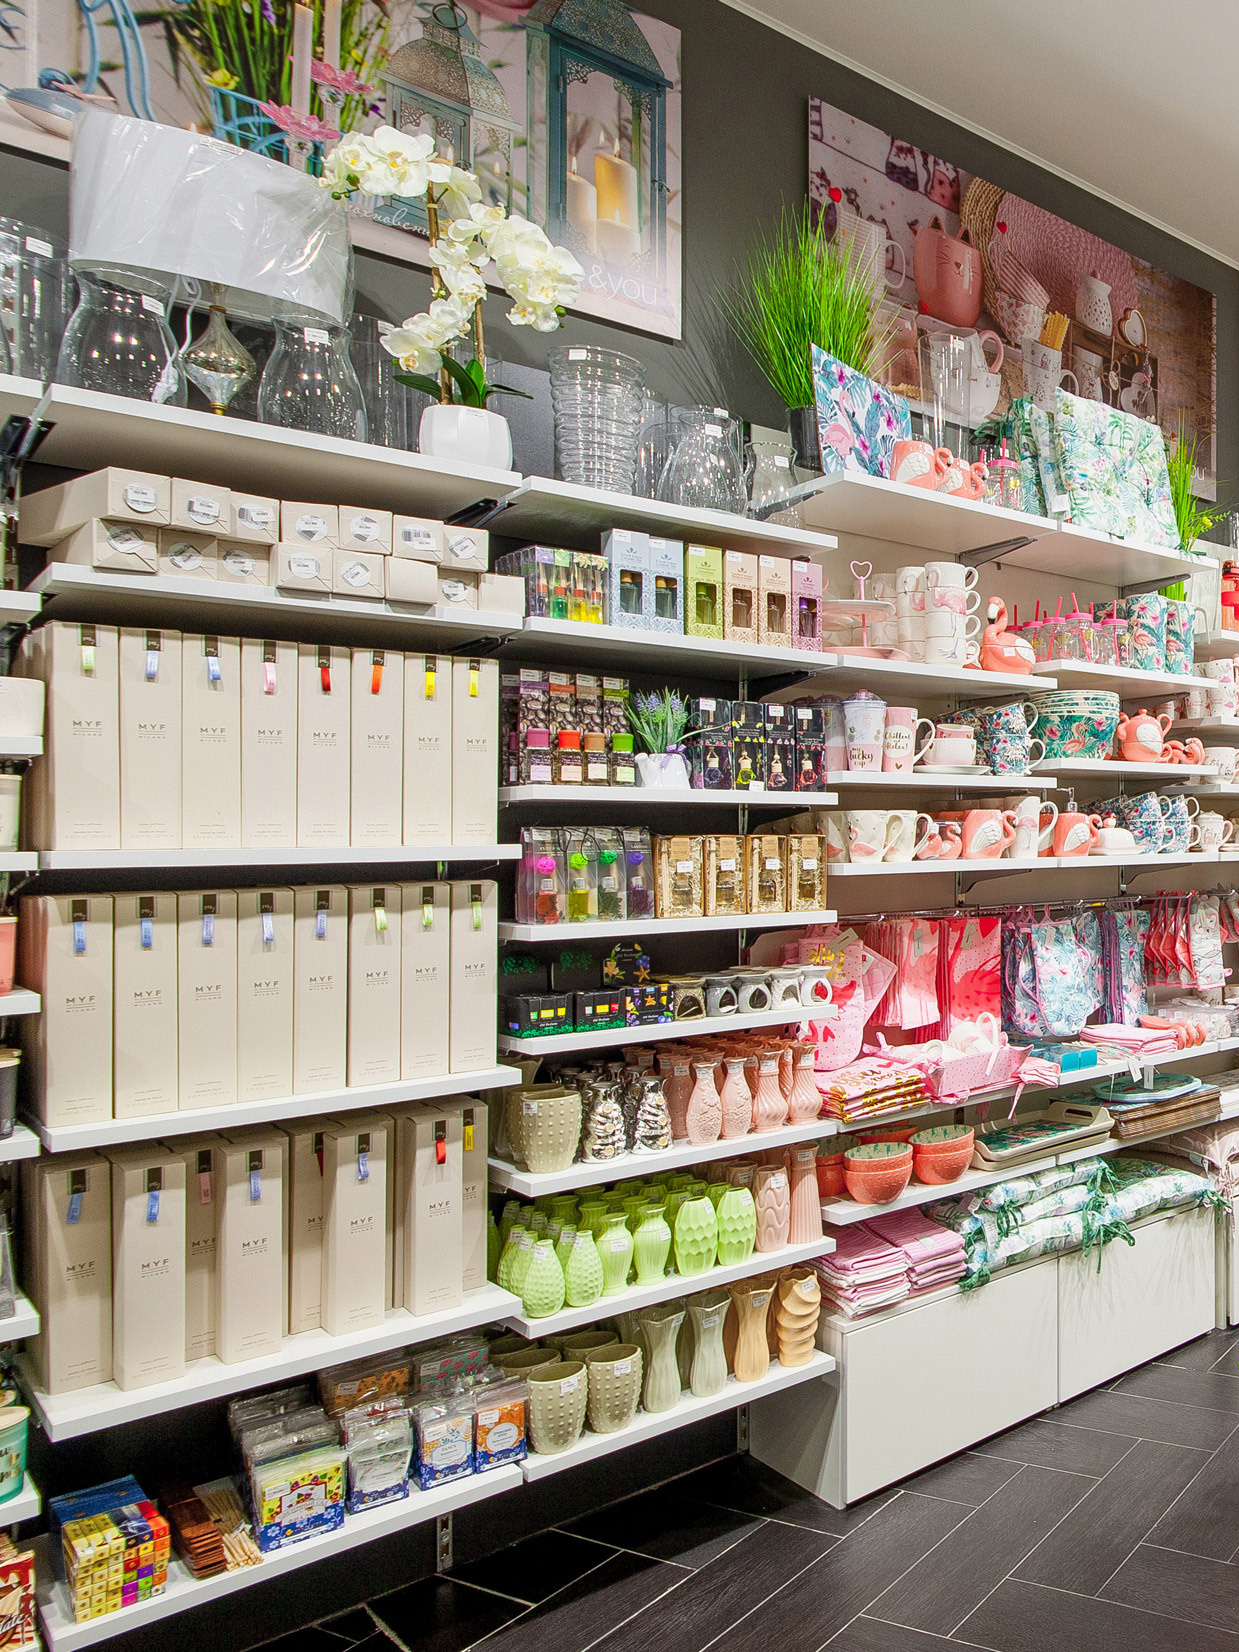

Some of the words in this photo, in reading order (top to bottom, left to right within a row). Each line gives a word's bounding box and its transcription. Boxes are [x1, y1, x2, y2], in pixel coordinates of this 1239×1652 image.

[72, 720, 102, 728] MYF
[415, 967, 437, 975] MYF
[195, 985, 222, 994] MYF
[254, 981, 279, 989] MYF
[134, 990, 162, 999] MYF
[66, 996, 96, 1005] MYF
[464, 1185, 477, 1193] YF
[429, 1201, 451, 1211] MYF
[308, 1216, 323, 1225] MY
[350, 1217, 373, 1227] MYF
[242, 1237, 268, 1249] MYF
[66, 1261, 95, 1274] MYF
[141, 1258, 169, 1270] MYF
